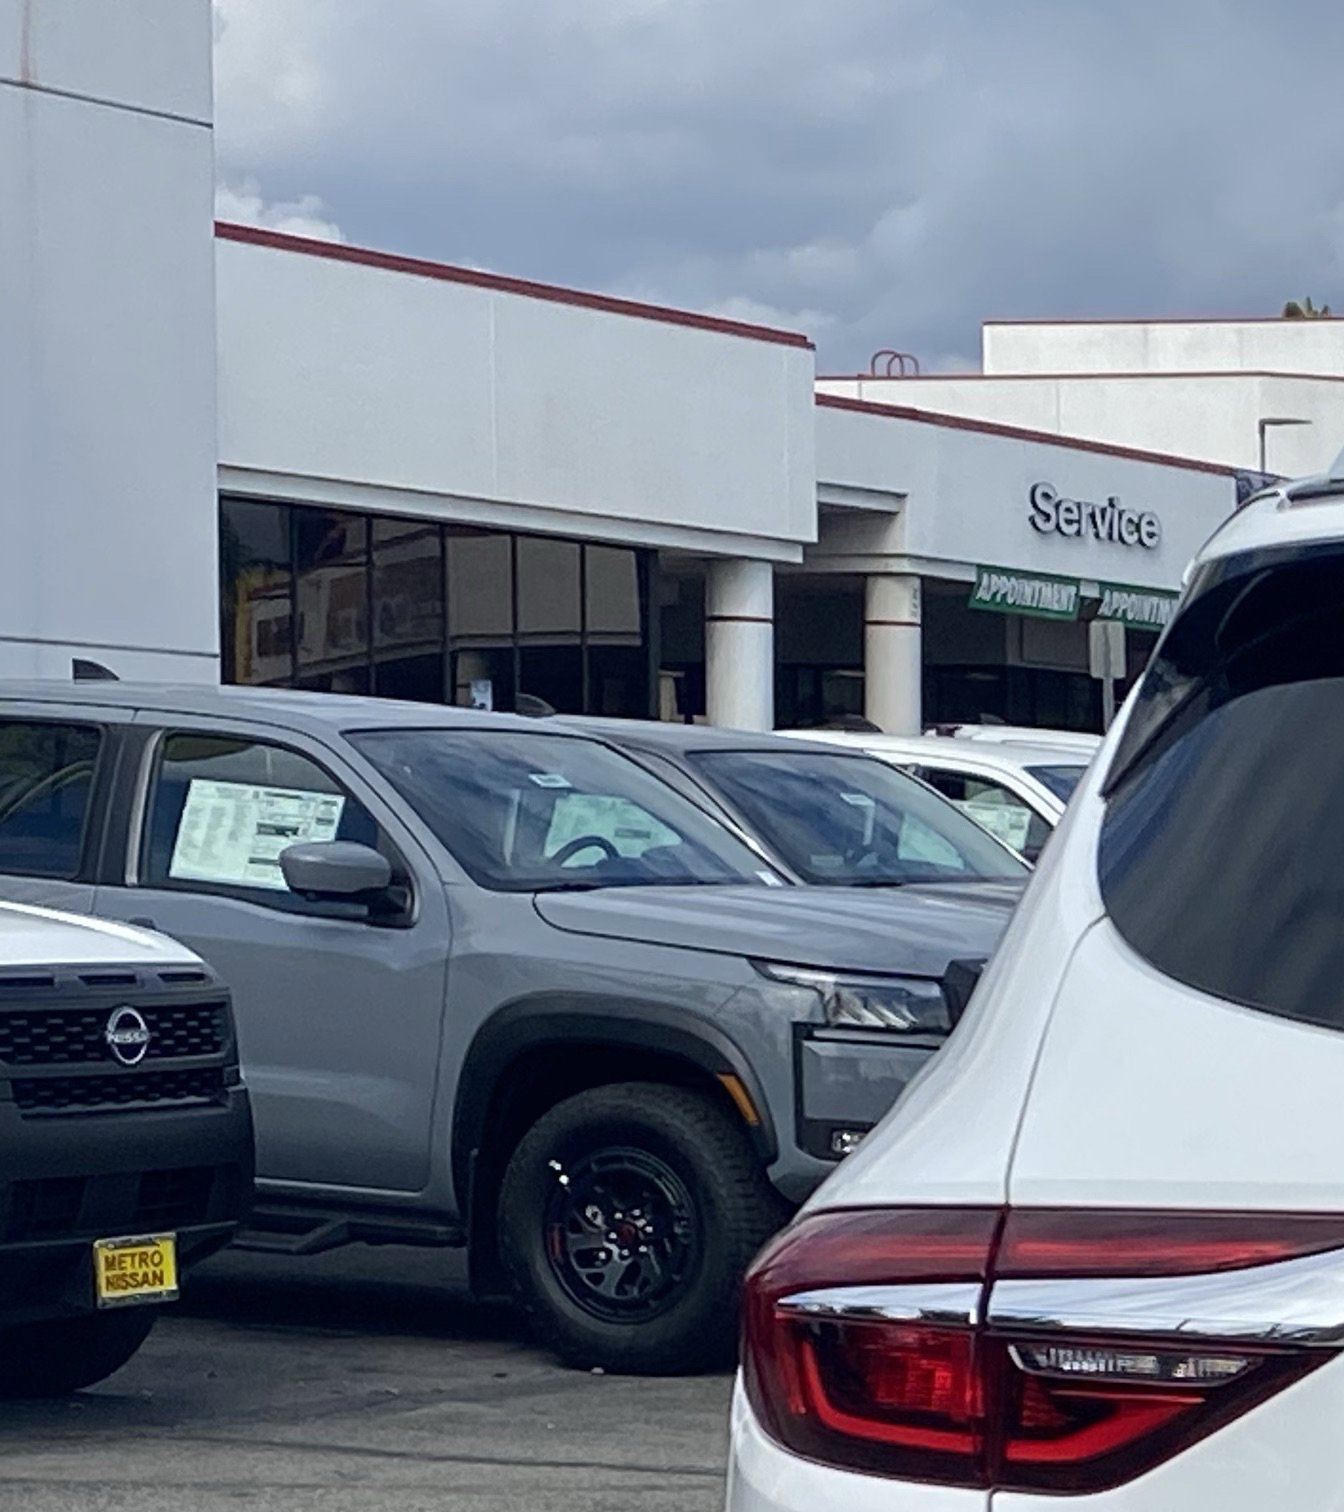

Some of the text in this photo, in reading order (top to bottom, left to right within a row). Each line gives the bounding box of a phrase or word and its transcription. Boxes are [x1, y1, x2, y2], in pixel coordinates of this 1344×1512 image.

[1029, 481, 1161, 548] Service
[976, 572, 1077, 612] APPOINTMENT
[104, 1250, 164, 1271] METRO
[105, 1269, 164, 1291] NISSAN
